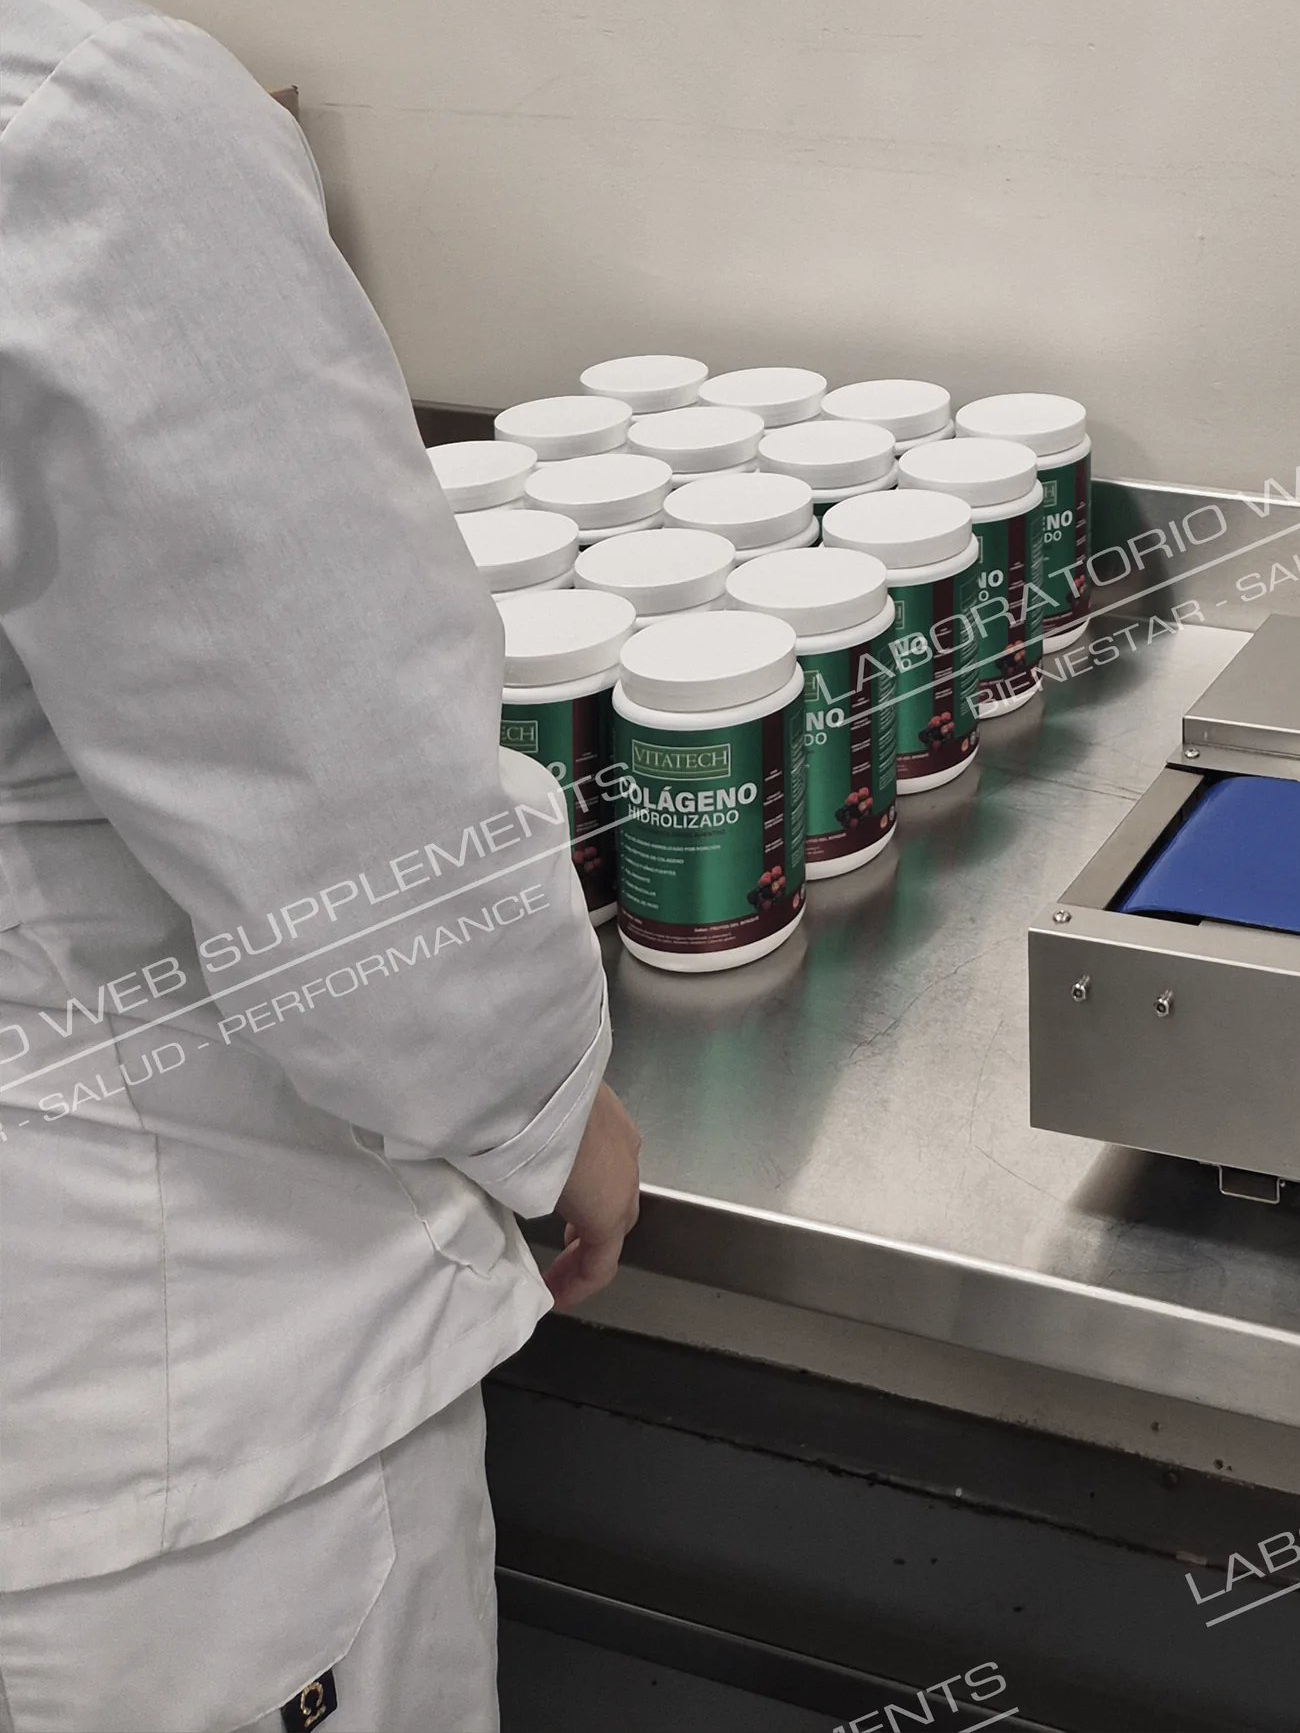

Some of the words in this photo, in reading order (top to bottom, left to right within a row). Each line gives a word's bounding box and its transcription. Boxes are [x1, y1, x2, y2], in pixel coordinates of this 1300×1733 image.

[634, 746, 728, 769] VITATECH
[619, 777, 757, 813] COLÁGENO
[628, 803, 739, 829] HIDROLIZADO
